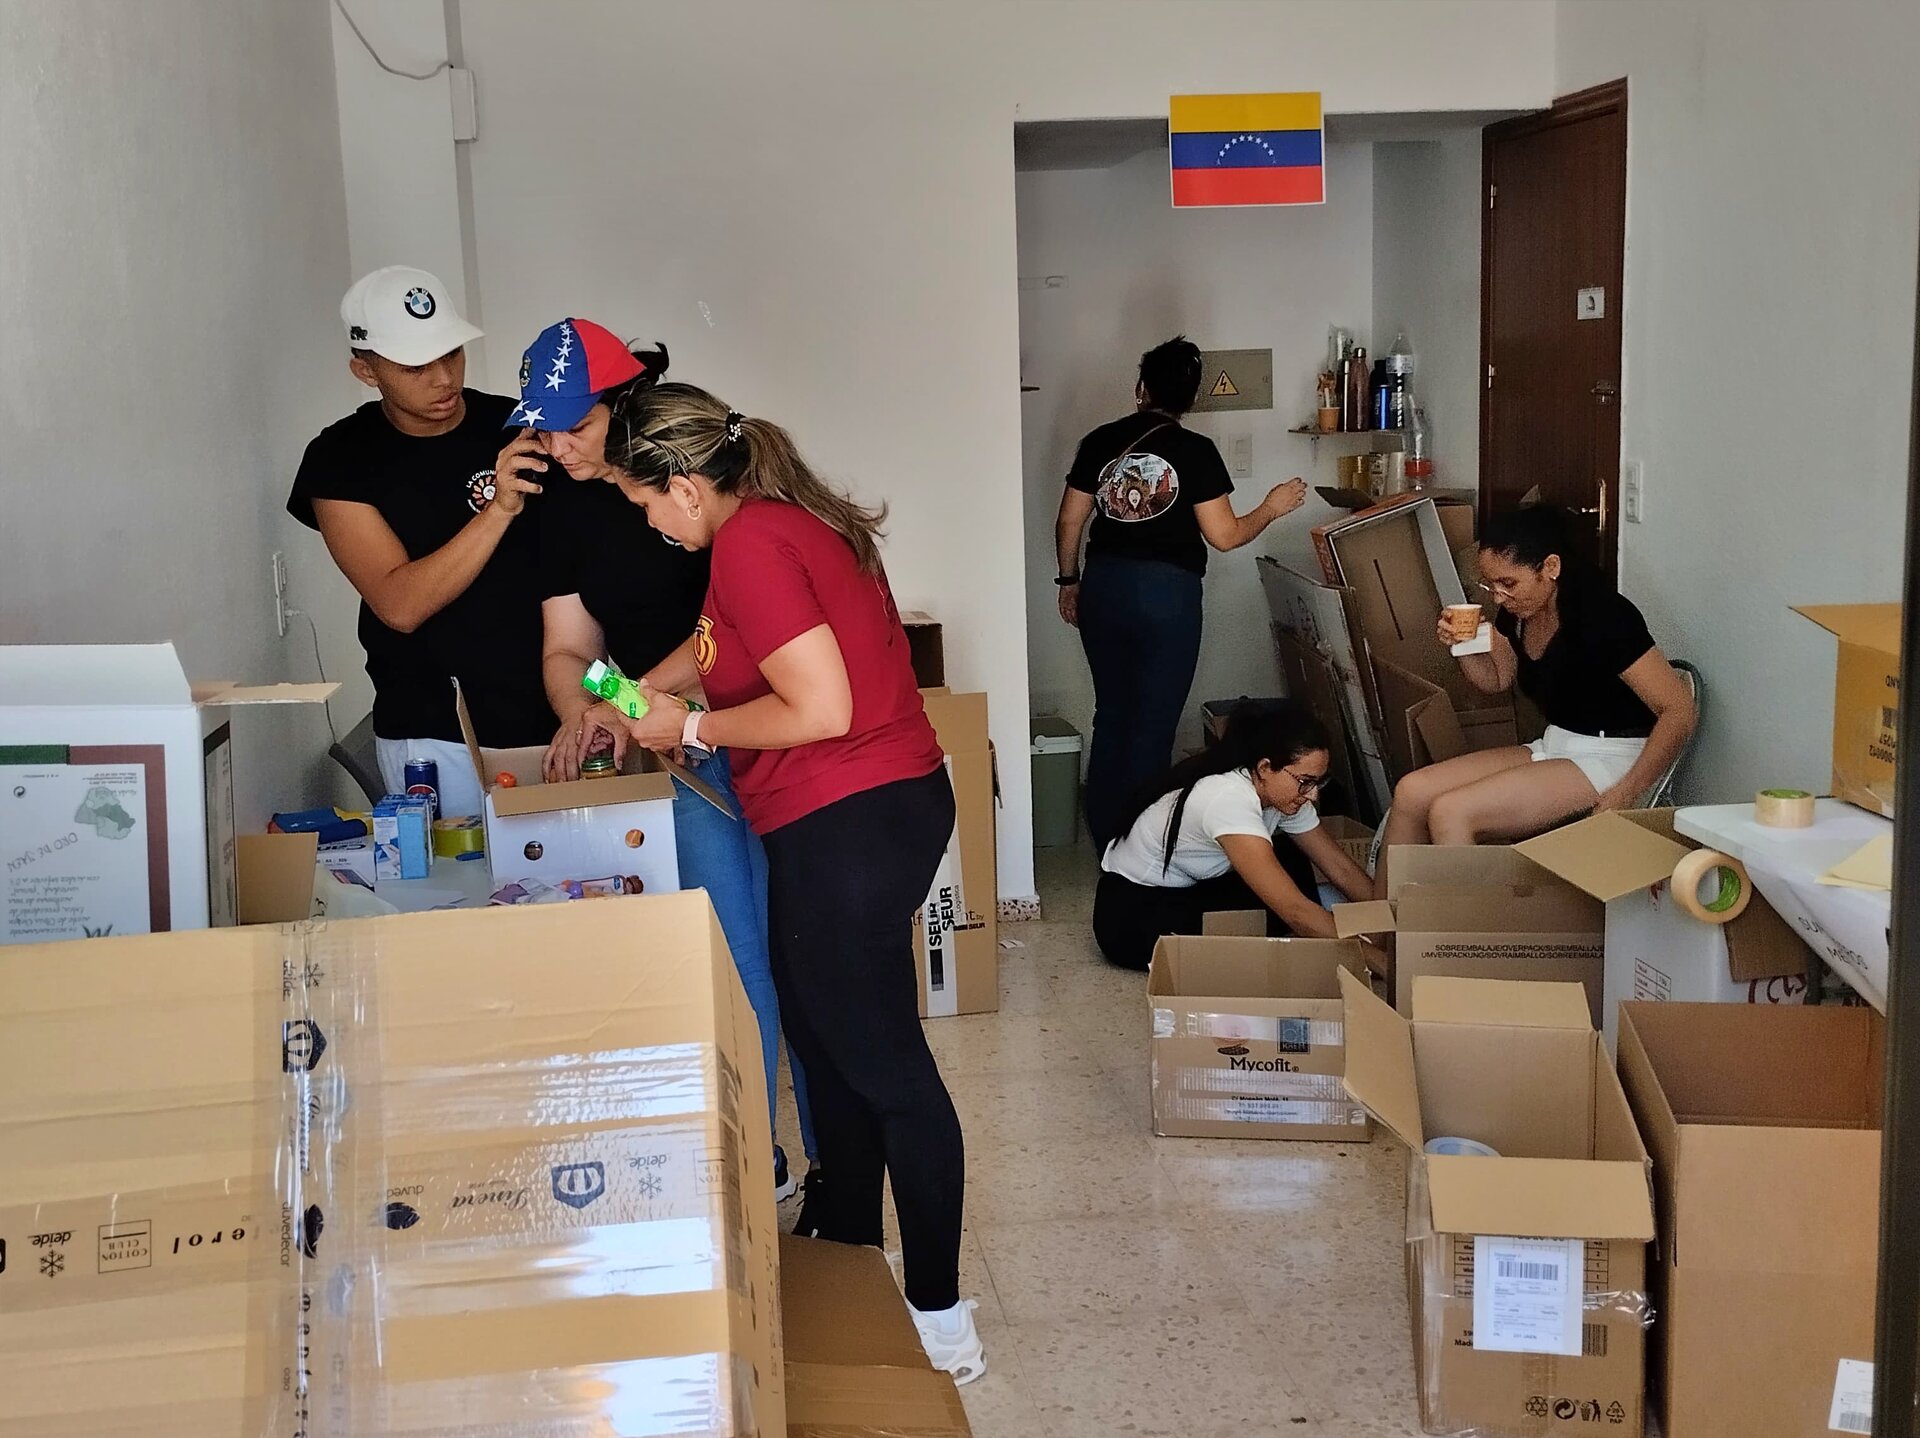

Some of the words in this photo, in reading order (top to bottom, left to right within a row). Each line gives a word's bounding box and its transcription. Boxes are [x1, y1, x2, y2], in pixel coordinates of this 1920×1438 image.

[472, 469, 497, 481] COMUN
[53, 832, 78, 850] ORO
[38, 844, 52, 857] DE
[940, 886, 955, 931] SEUR
[283, 960, 297, 998] deide
[630, 1153, 667, 1170] deide
[31, 1230, 72, 1248] deide
[108, 1238, 140, 1250] CLUB
[101, 1248, 148, 1262] COTTON
